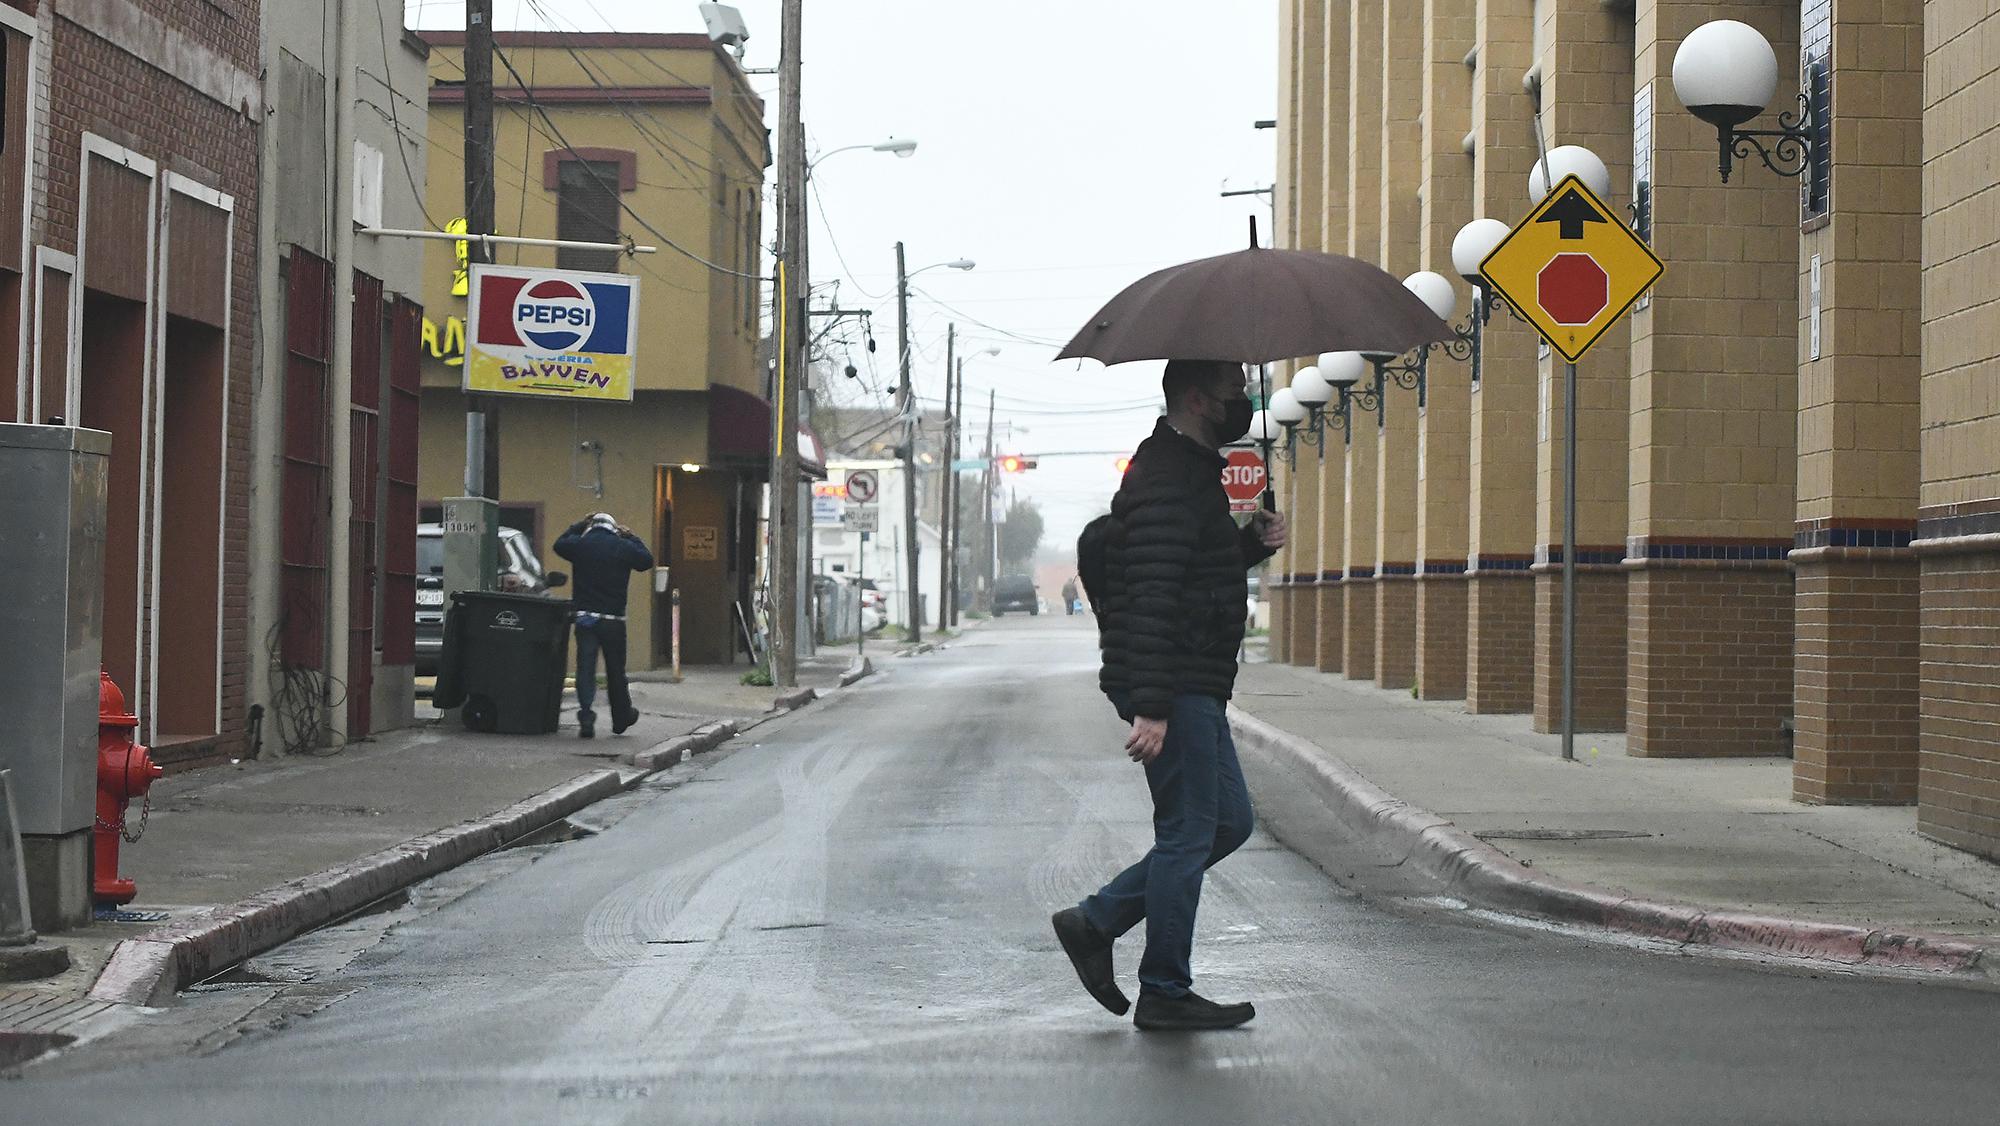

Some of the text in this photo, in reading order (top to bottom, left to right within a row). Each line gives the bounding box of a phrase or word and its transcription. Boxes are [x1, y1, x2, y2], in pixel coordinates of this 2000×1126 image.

[518, 304, 590, 326] PEPSI
[501, 364, 610, 389] BAYVEN
[1221, 465, 1265, 485] STOP
[846, 511, 878, 520] NO LEFT
[852, 521, 872, 529] TURN
